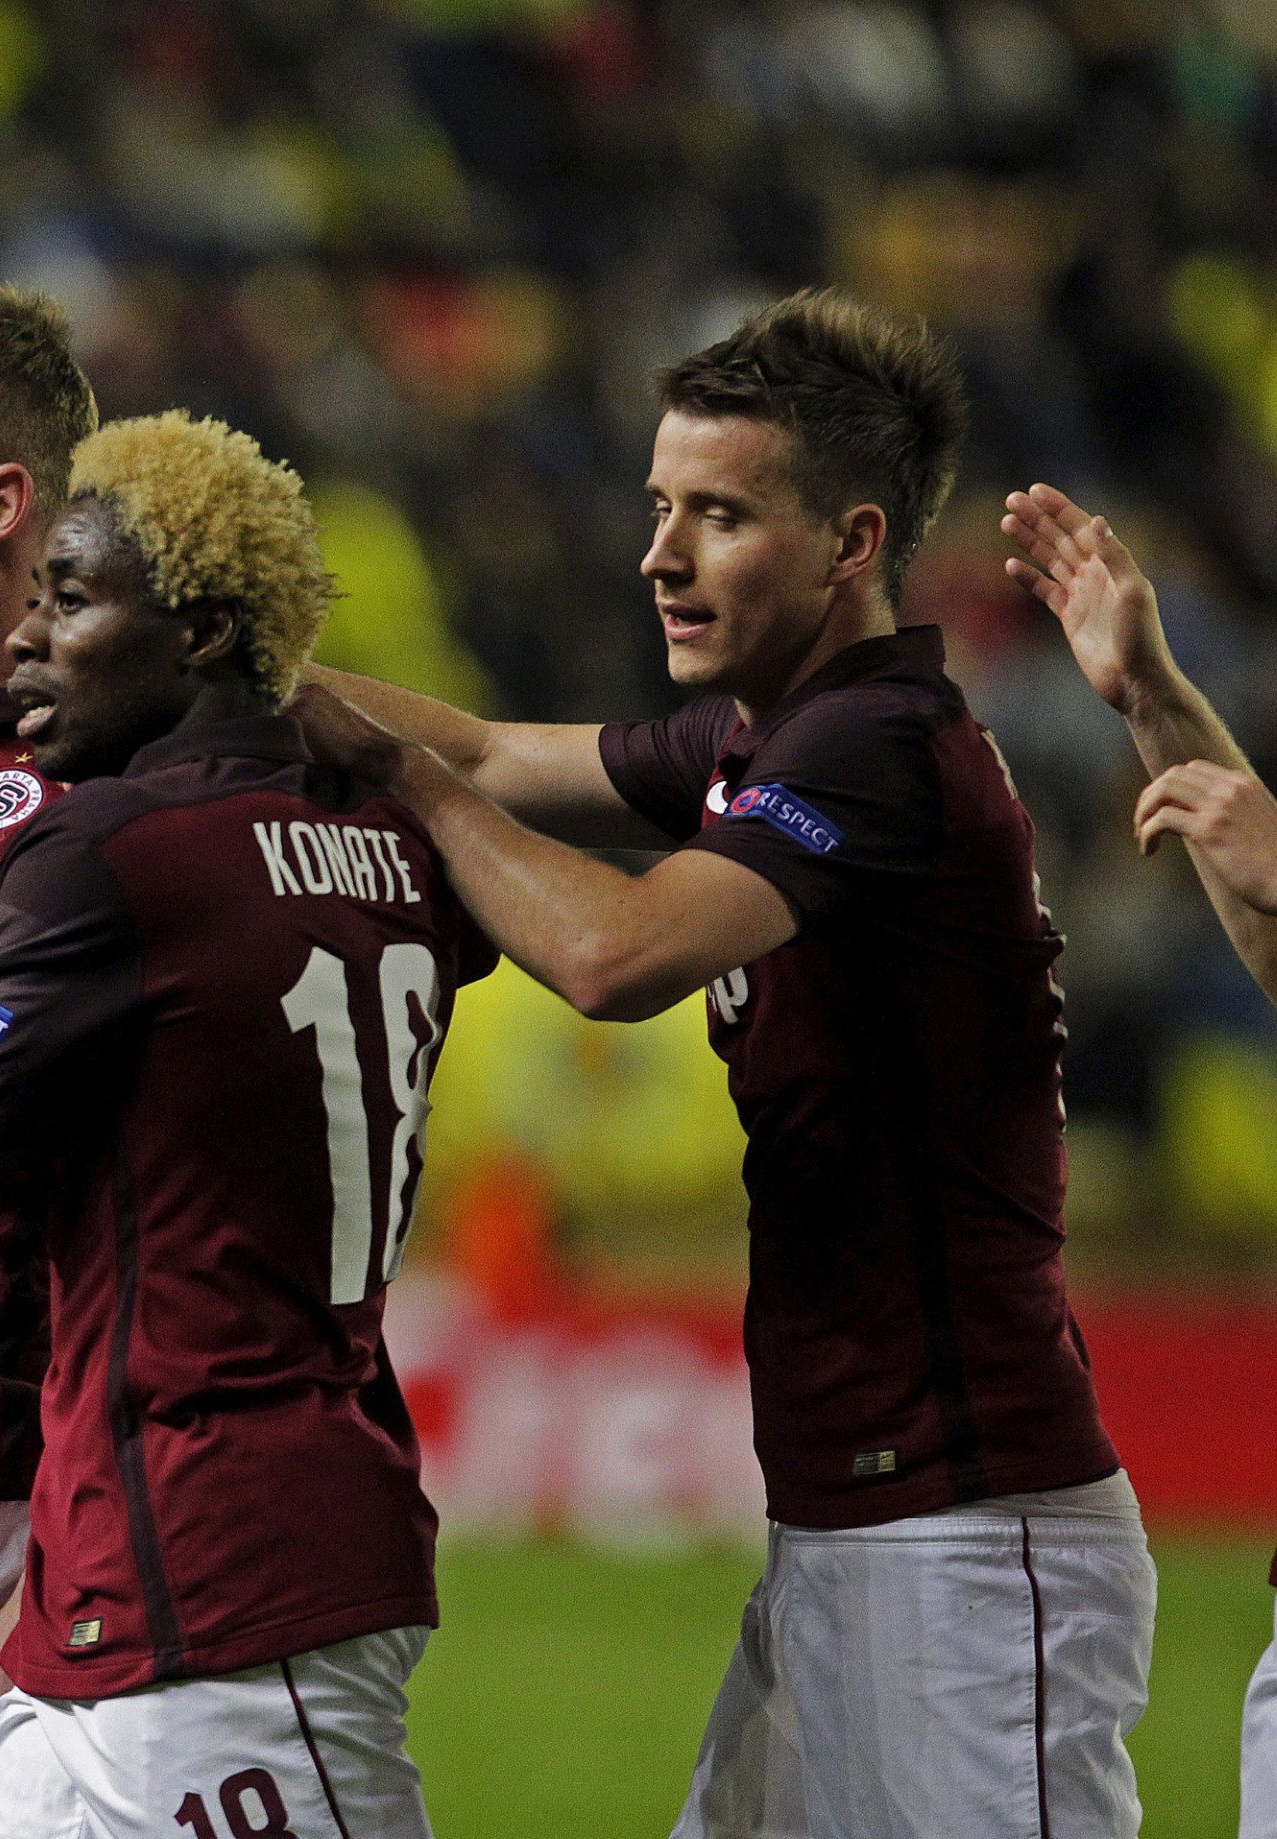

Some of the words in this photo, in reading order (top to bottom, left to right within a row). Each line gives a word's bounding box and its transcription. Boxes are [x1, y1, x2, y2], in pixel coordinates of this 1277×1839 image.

[252, 821, 422, 903] KONATE
[756, 791, 840, 853] RESPECT
[280, 943, 444, 1306] 18
